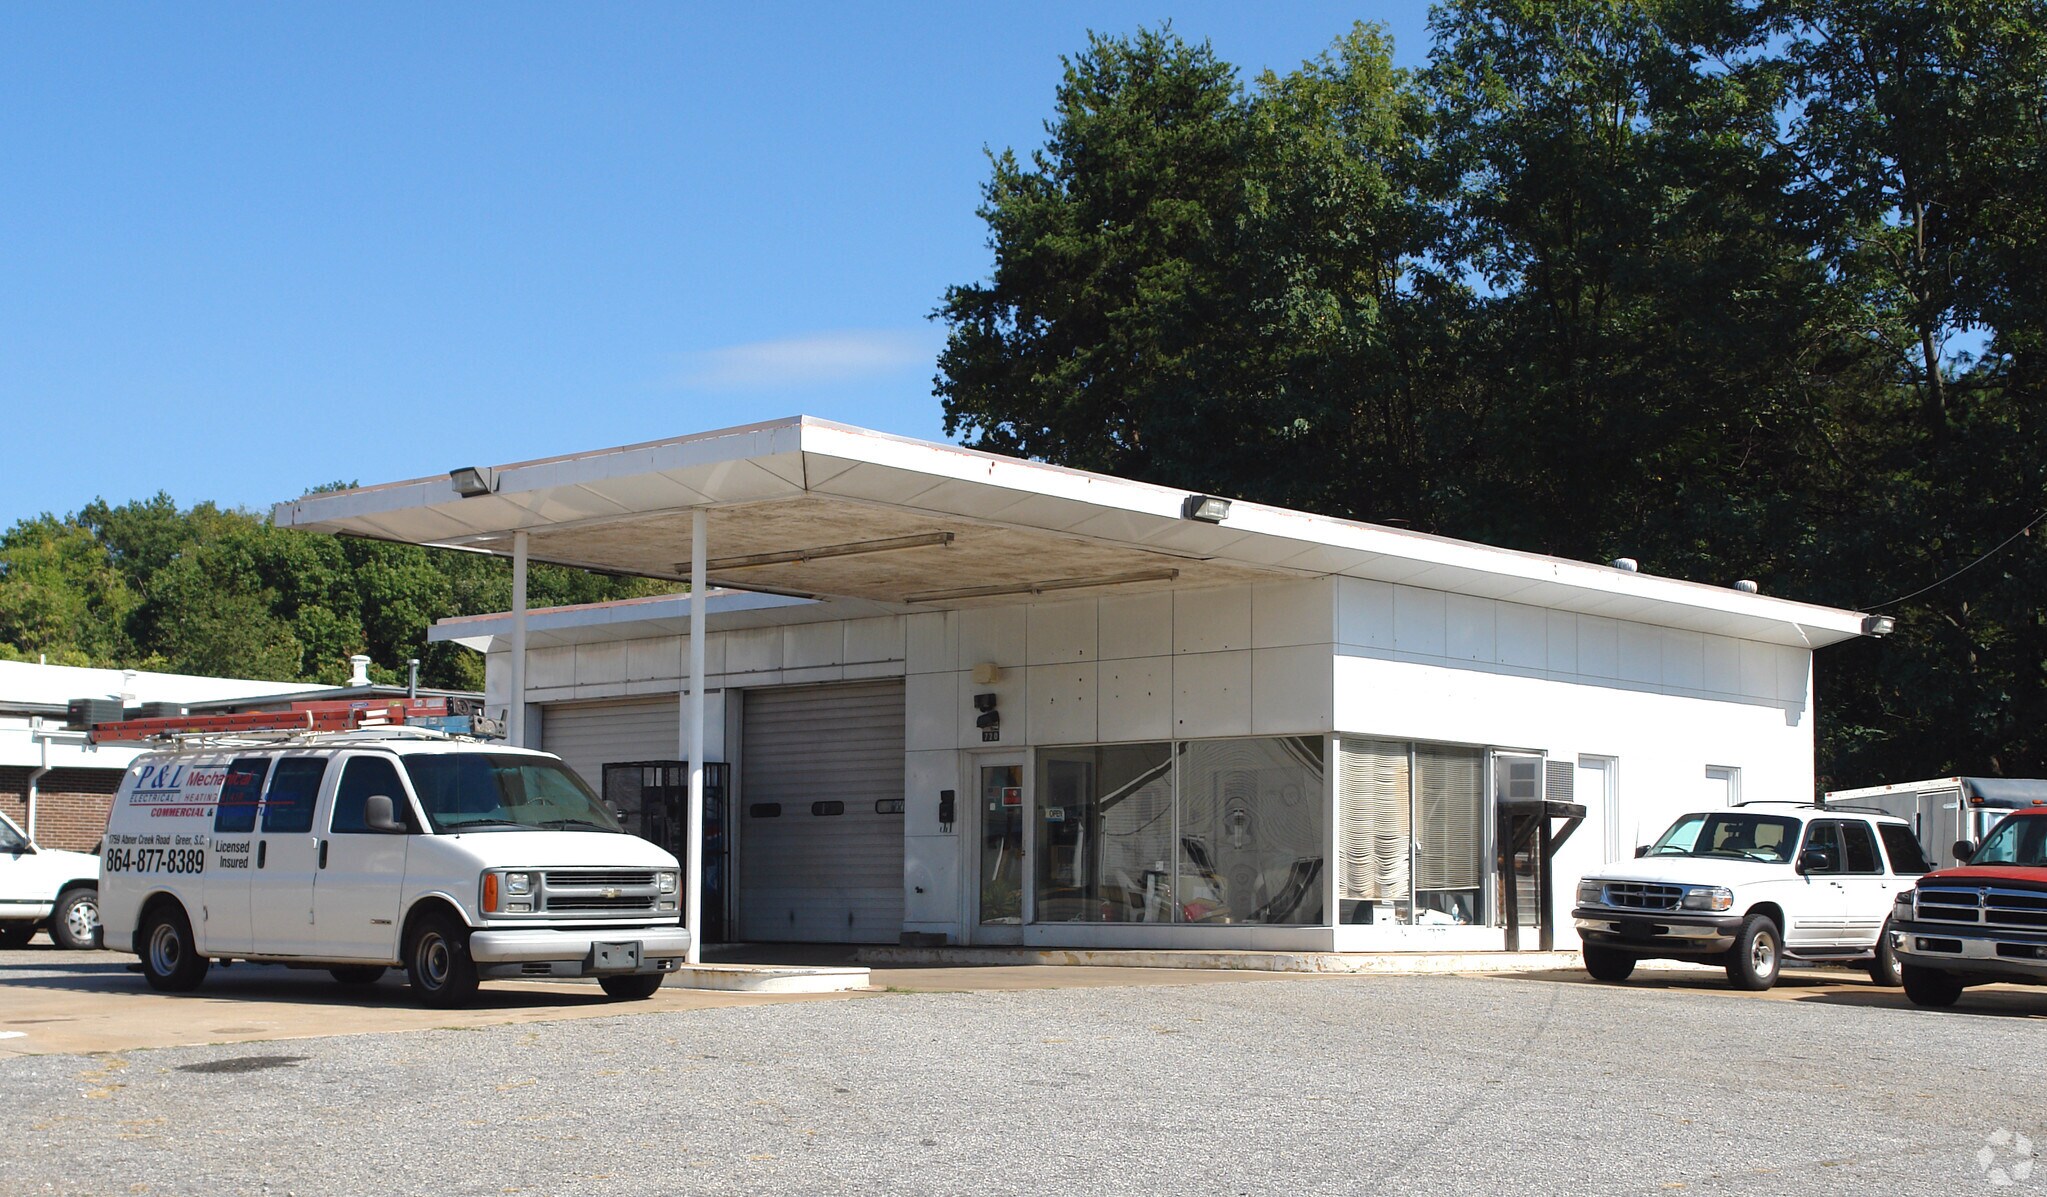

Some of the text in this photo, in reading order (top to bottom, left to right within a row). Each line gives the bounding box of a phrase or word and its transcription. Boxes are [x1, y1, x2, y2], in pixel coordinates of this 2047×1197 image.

[136, 765, 253, 789] P&L Mechanical
[130, 794, 174, 803] ELECTRICAL
[184, 793, 218, 802] HEATING
[151, 808, 205, 818] COMMERCIAL
[207, 808, 213, 817] &
[1049, 810, 1063, 818] OPEN
[109, 834, 205, 846] 1759 Abner Creek Road Greer, S.C.
[215, 840, 250, 853] Licensed
[106, 848, 205, 874] 864-877-8389
[219, 856, 249, 868] Insured
